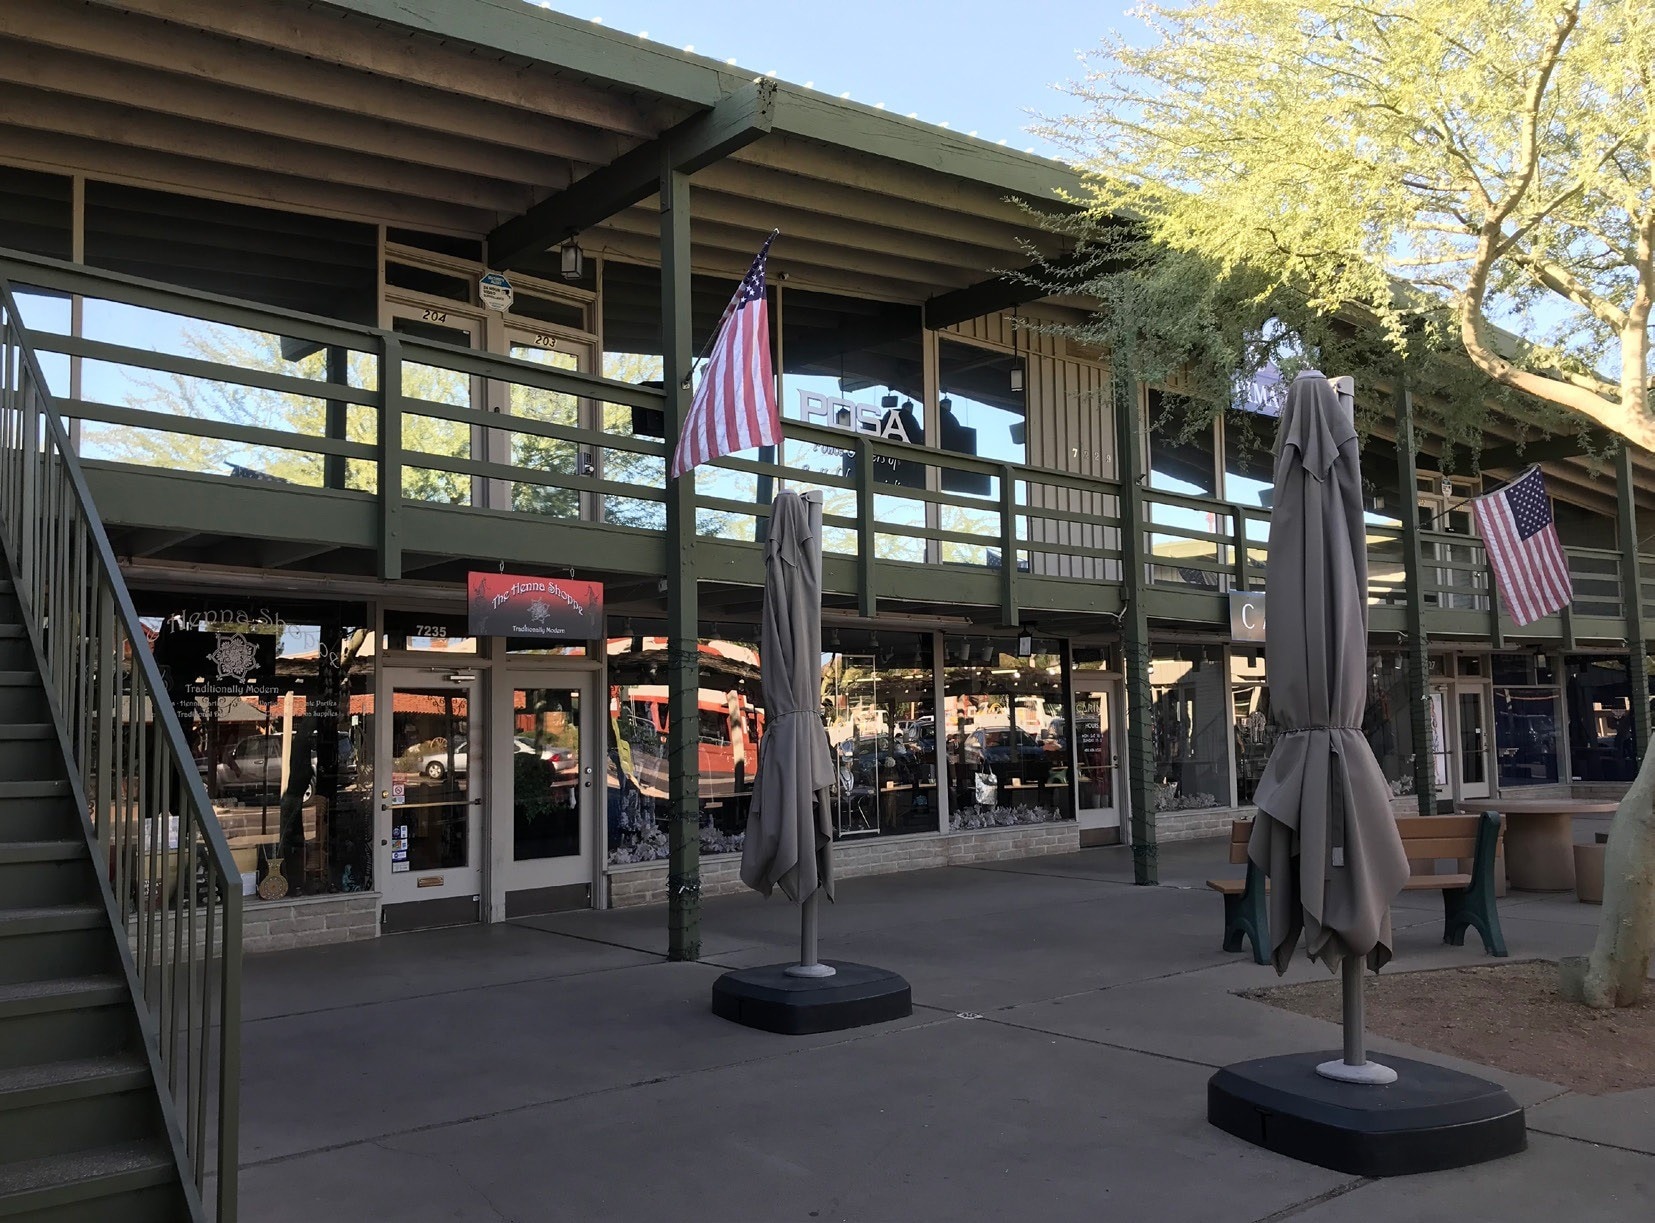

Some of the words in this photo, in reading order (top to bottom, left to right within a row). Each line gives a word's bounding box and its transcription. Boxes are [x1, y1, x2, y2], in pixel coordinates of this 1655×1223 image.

[422, 309, 447, 324] 204
[535, 335, 556, 348] 203
[797, 388, 911, 443] POSA
[492, 591, 509, 609] The
[511, 581, 546, 596] Henna
[549, 581, 583, 615] Shoppe
[416, 625, 447, 638] 7235
[513, 624, 545, 634] Traditionally
[166, 609, 249, 634] Henna
[260, 608, 339, 669] Shoppe
[185, 682, 243, 695] Traditionally
[246, 685, 279, 693] Modern
